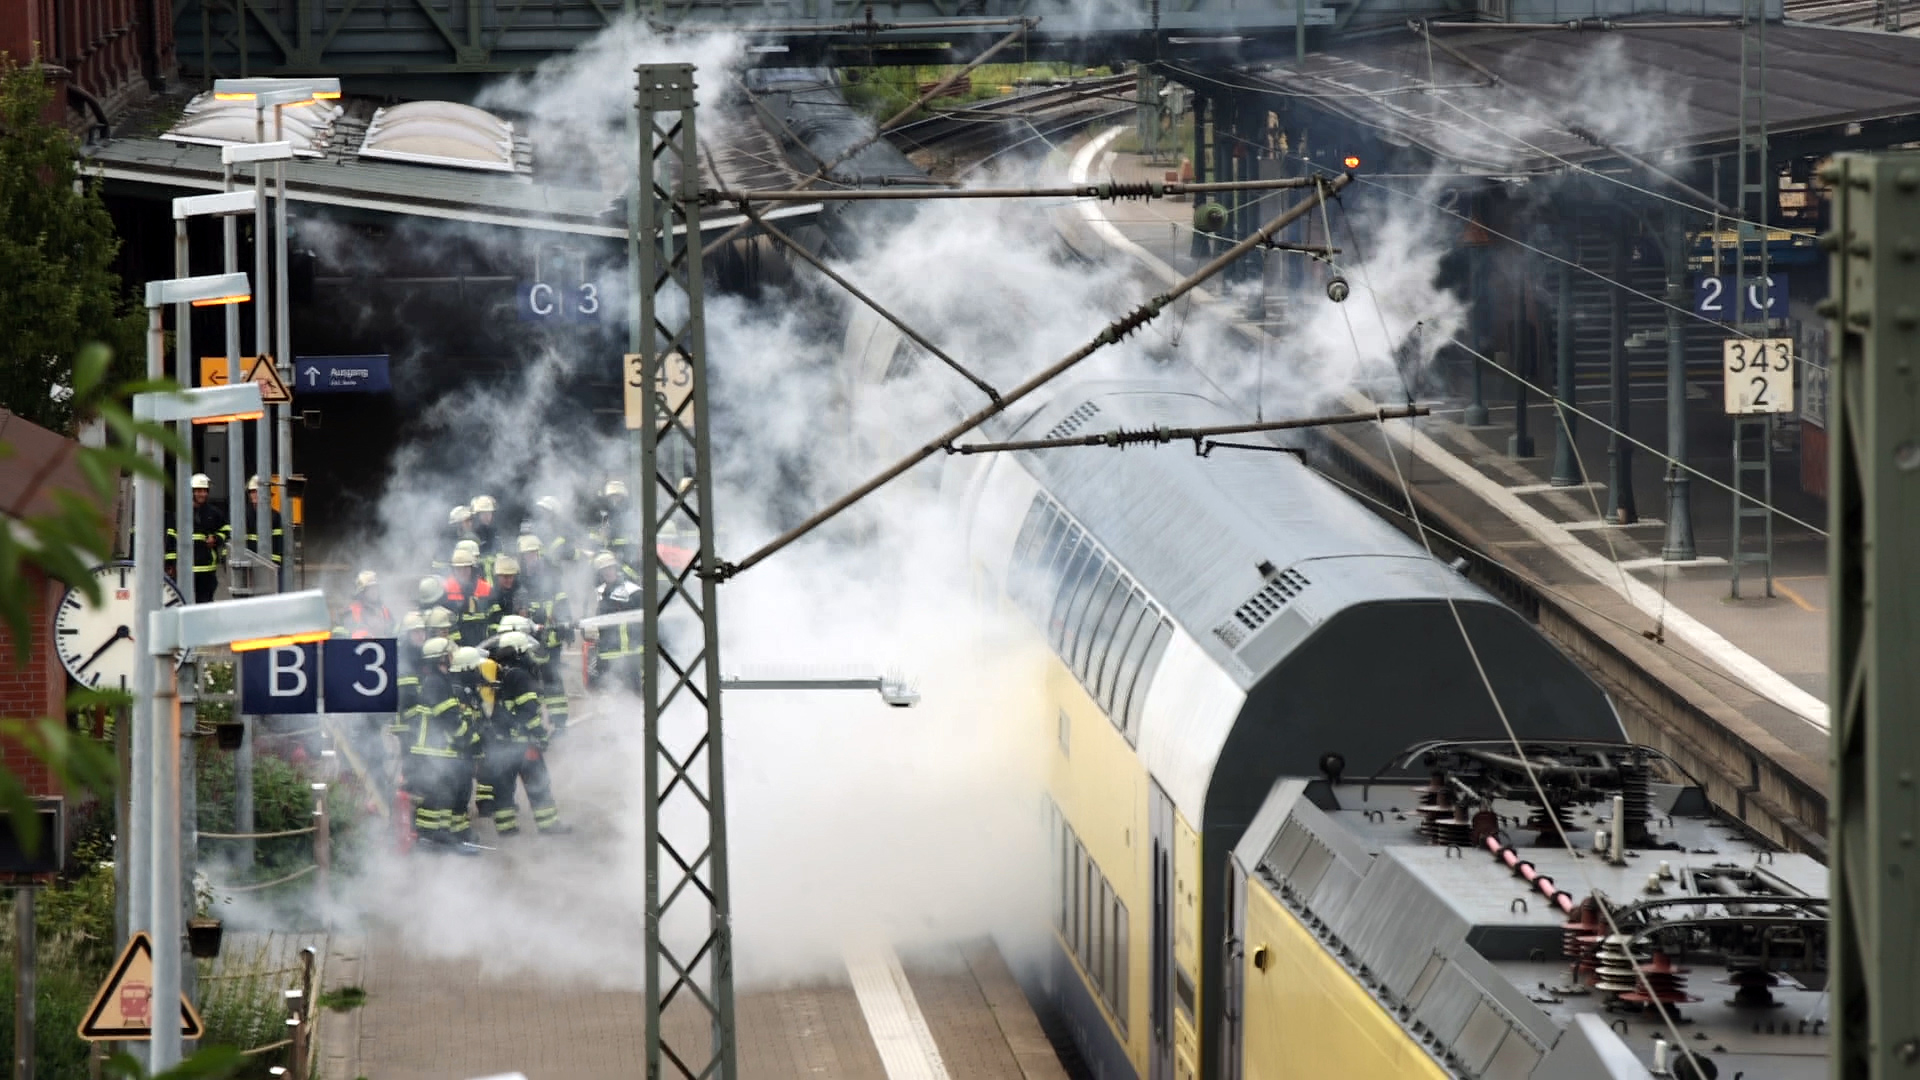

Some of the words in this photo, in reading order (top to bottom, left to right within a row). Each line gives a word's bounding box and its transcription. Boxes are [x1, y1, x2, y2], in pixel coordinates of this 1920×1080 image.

[530, 283, 553, 315] C
[579, 282, 599, 314] 3
[1701, 277, 1722, 311] 2
[1749, 276, 1776, 310] C
[1730, 343, 1790, 373] 343
[1751, 376, 1769, 406] 2
[269, 645, 308, 697] B
[352, 641, 388, 697] 3
